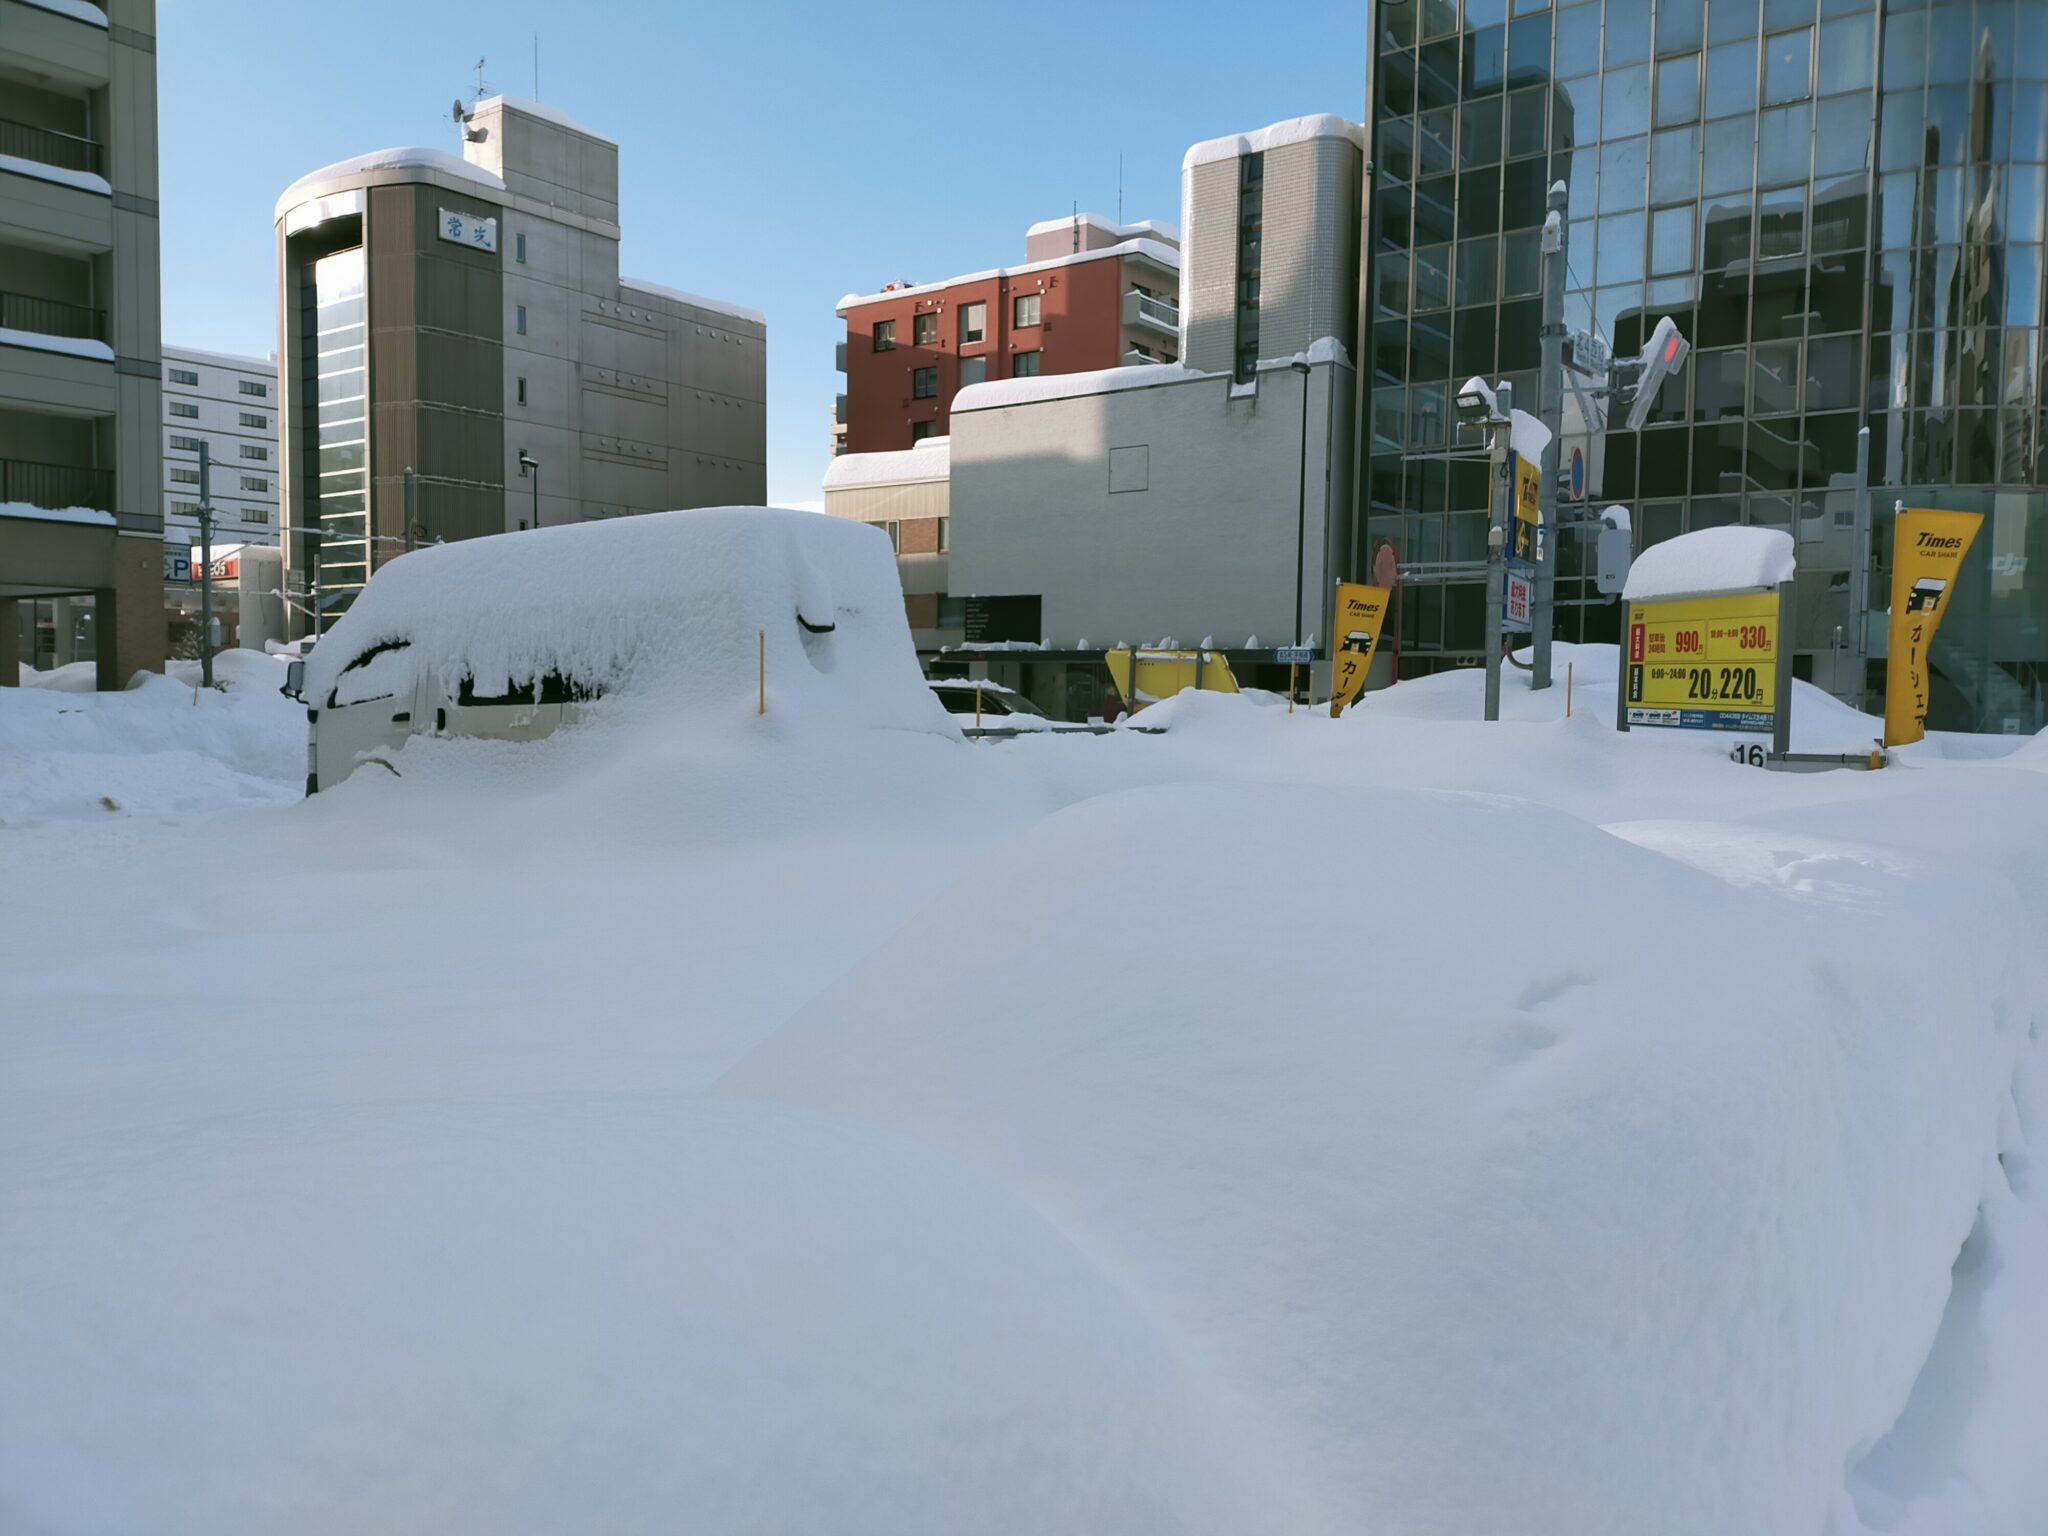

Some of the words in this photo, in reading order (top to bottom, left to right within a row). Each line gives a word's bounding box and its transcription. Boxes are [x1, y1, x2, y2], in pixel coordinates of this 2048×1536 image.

[1916, 532, 1963, 548] Times
[1920, 550, 1937, 558] CAR
[174, 560, 189, 577] P
[1347, 599, 1381, 612] Times
[1735, 744, 1764, 768] 16
